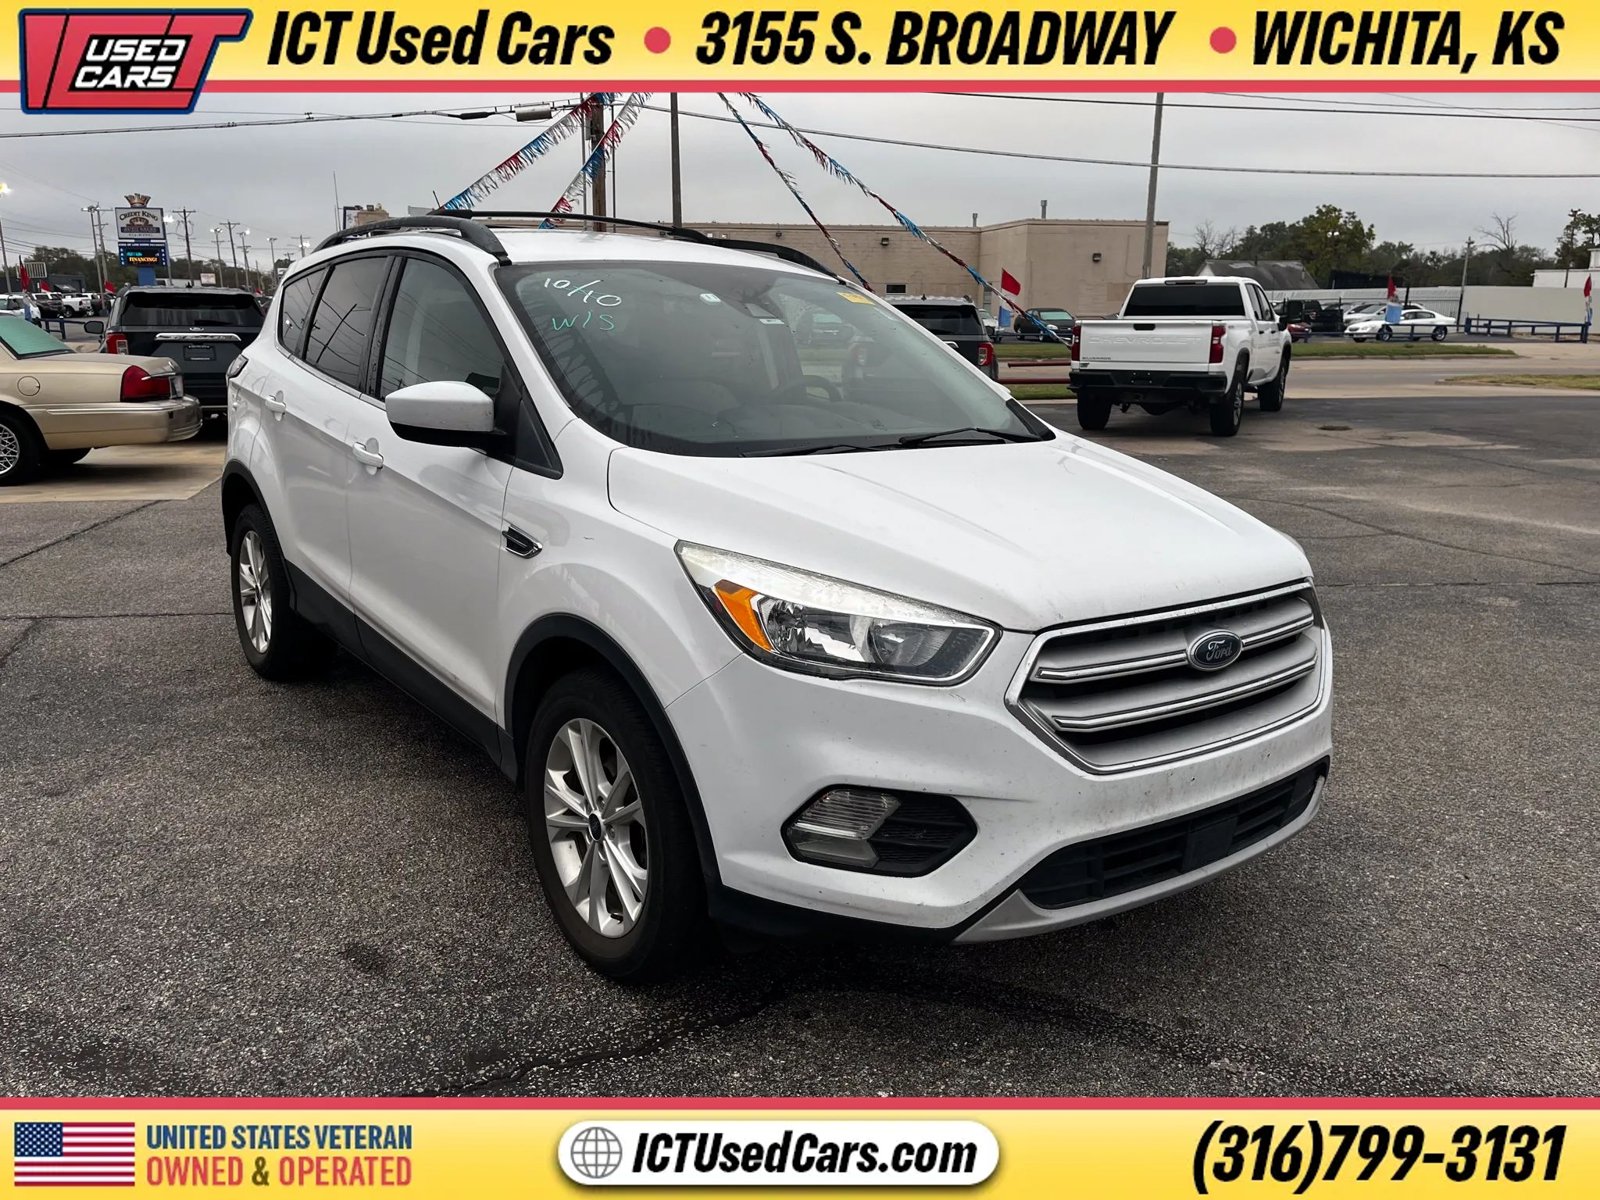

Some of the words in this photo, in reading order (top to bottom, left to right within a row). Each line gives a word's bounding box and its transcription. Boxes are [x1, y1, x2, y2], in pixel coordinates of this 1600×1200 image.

[544, 278, 622, 307] 10/10
[1087, 336, 1201, 345] CHEVROLET
[1205, 639, 1233, 661] Ford
